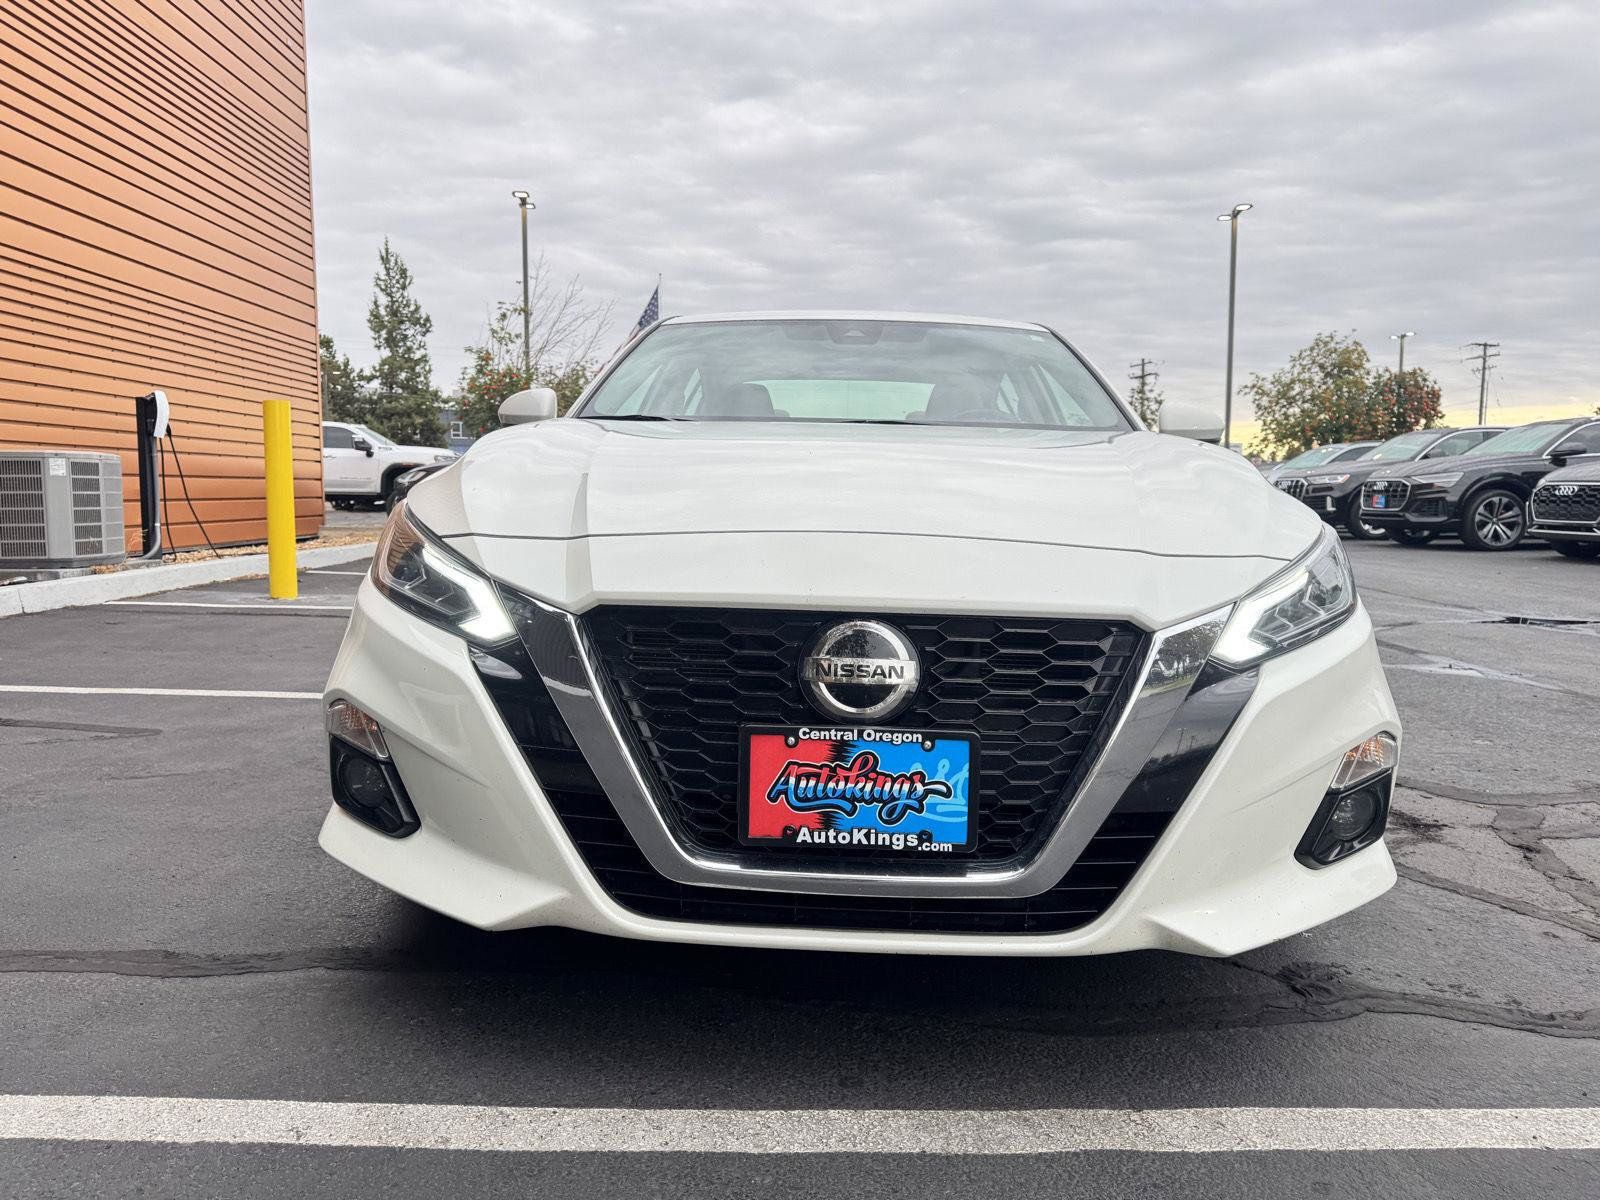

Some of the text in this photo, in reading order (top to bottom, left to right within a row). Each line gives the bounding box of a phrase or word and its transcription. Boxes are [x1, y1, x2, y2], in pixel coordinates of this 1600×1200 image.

[815, 661, 905, 680] NISSAN
[798, 727, 923, 743] Central Oregon
[796, 827, 953, 852] AutoKings.com
